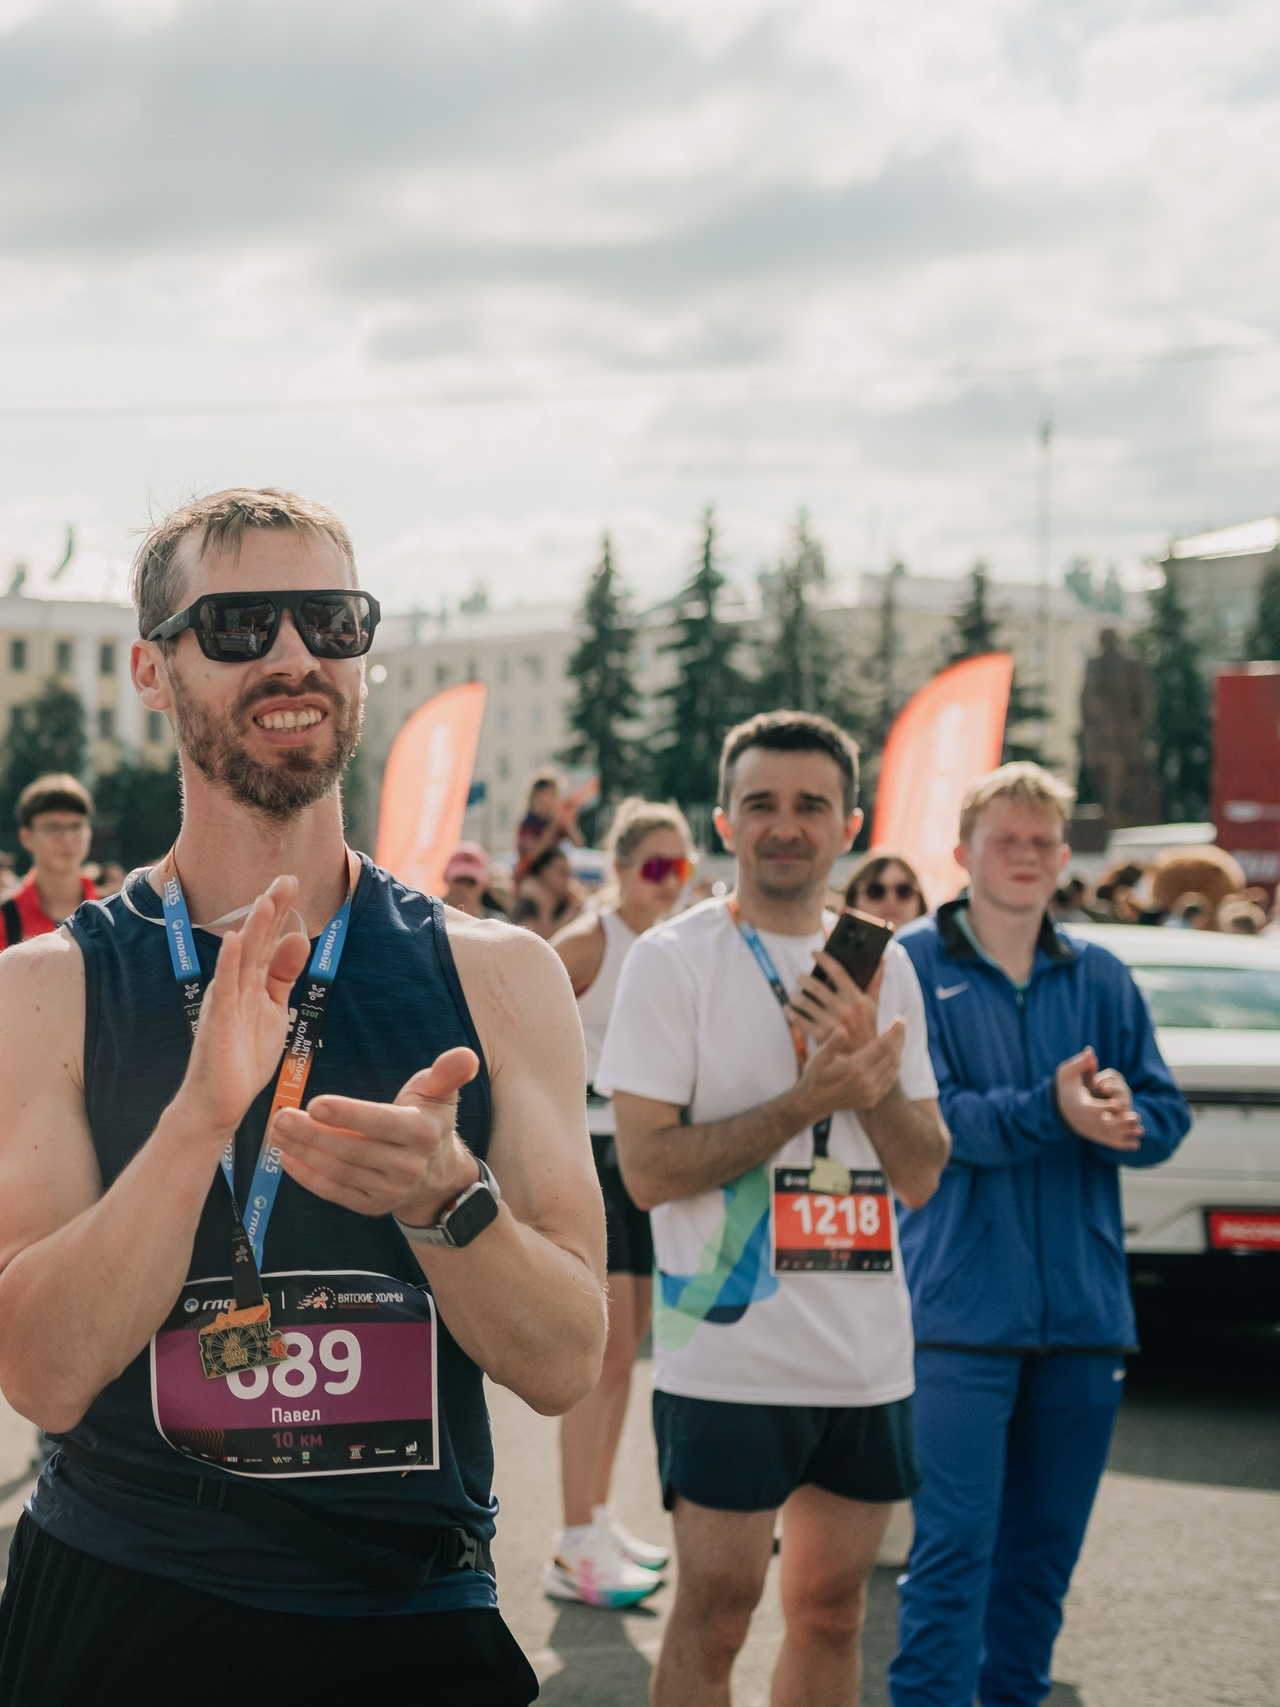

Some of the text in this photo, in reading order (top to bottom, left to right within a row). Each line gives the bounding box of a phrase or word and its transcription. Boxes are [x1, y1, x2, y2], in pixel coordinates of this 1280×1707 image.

[166, 877, 180, 906] 2025
[301, 1009, 319, 1019] 2025
[292, 1040, 312, 1083] ВЯТСКИЕ
[265, 1146, 282, 1174] 025
[792, 1195, 880, 1236] 1218
[337, 1292, 374, 1303] ВЯТСКИЕ
[375, 1292, 404, 1303] ХОЛМЫ
[271, 1408, 321, 1424] Павел
[272, 1432, 294, 1448] 10
